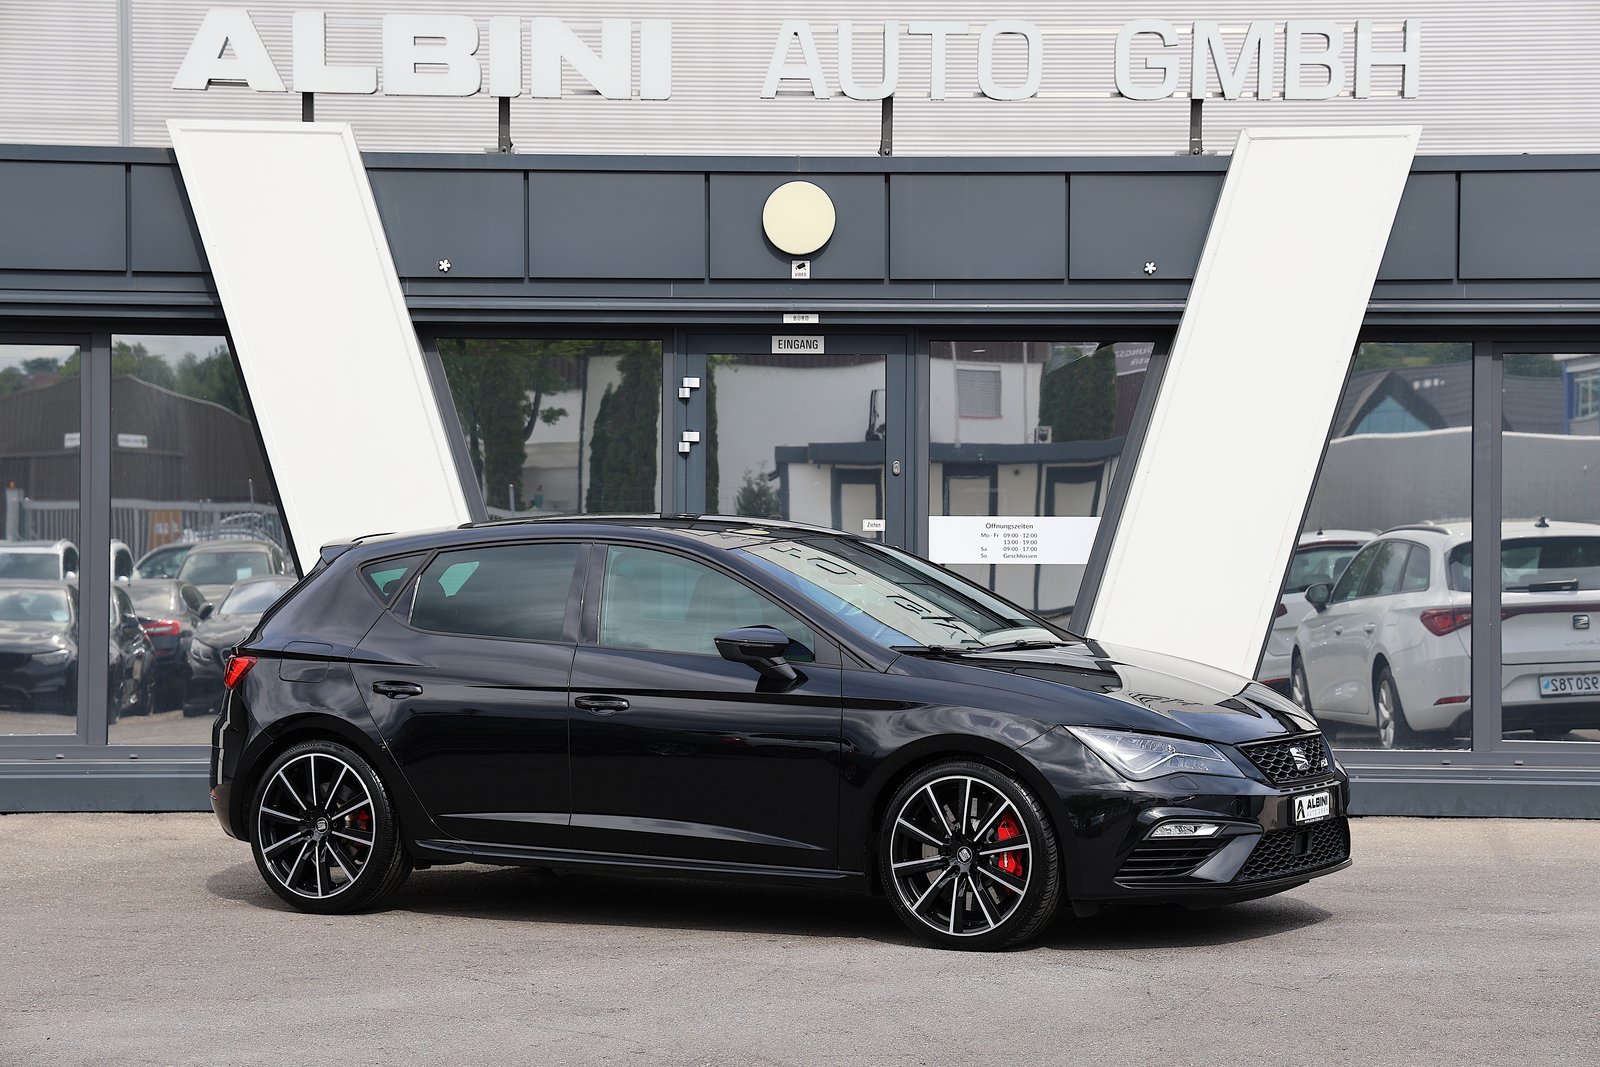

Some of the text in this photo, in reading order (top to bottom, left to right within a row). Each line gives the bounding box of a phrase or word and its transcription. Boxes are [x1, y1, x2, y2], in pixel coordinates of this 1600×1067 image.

[172, 9, 1422, 101] ALBINI AUTO GMBH
[778, 339, 819, 350] EINGANG
[1306, 795, 1328, 810] ALBINI
